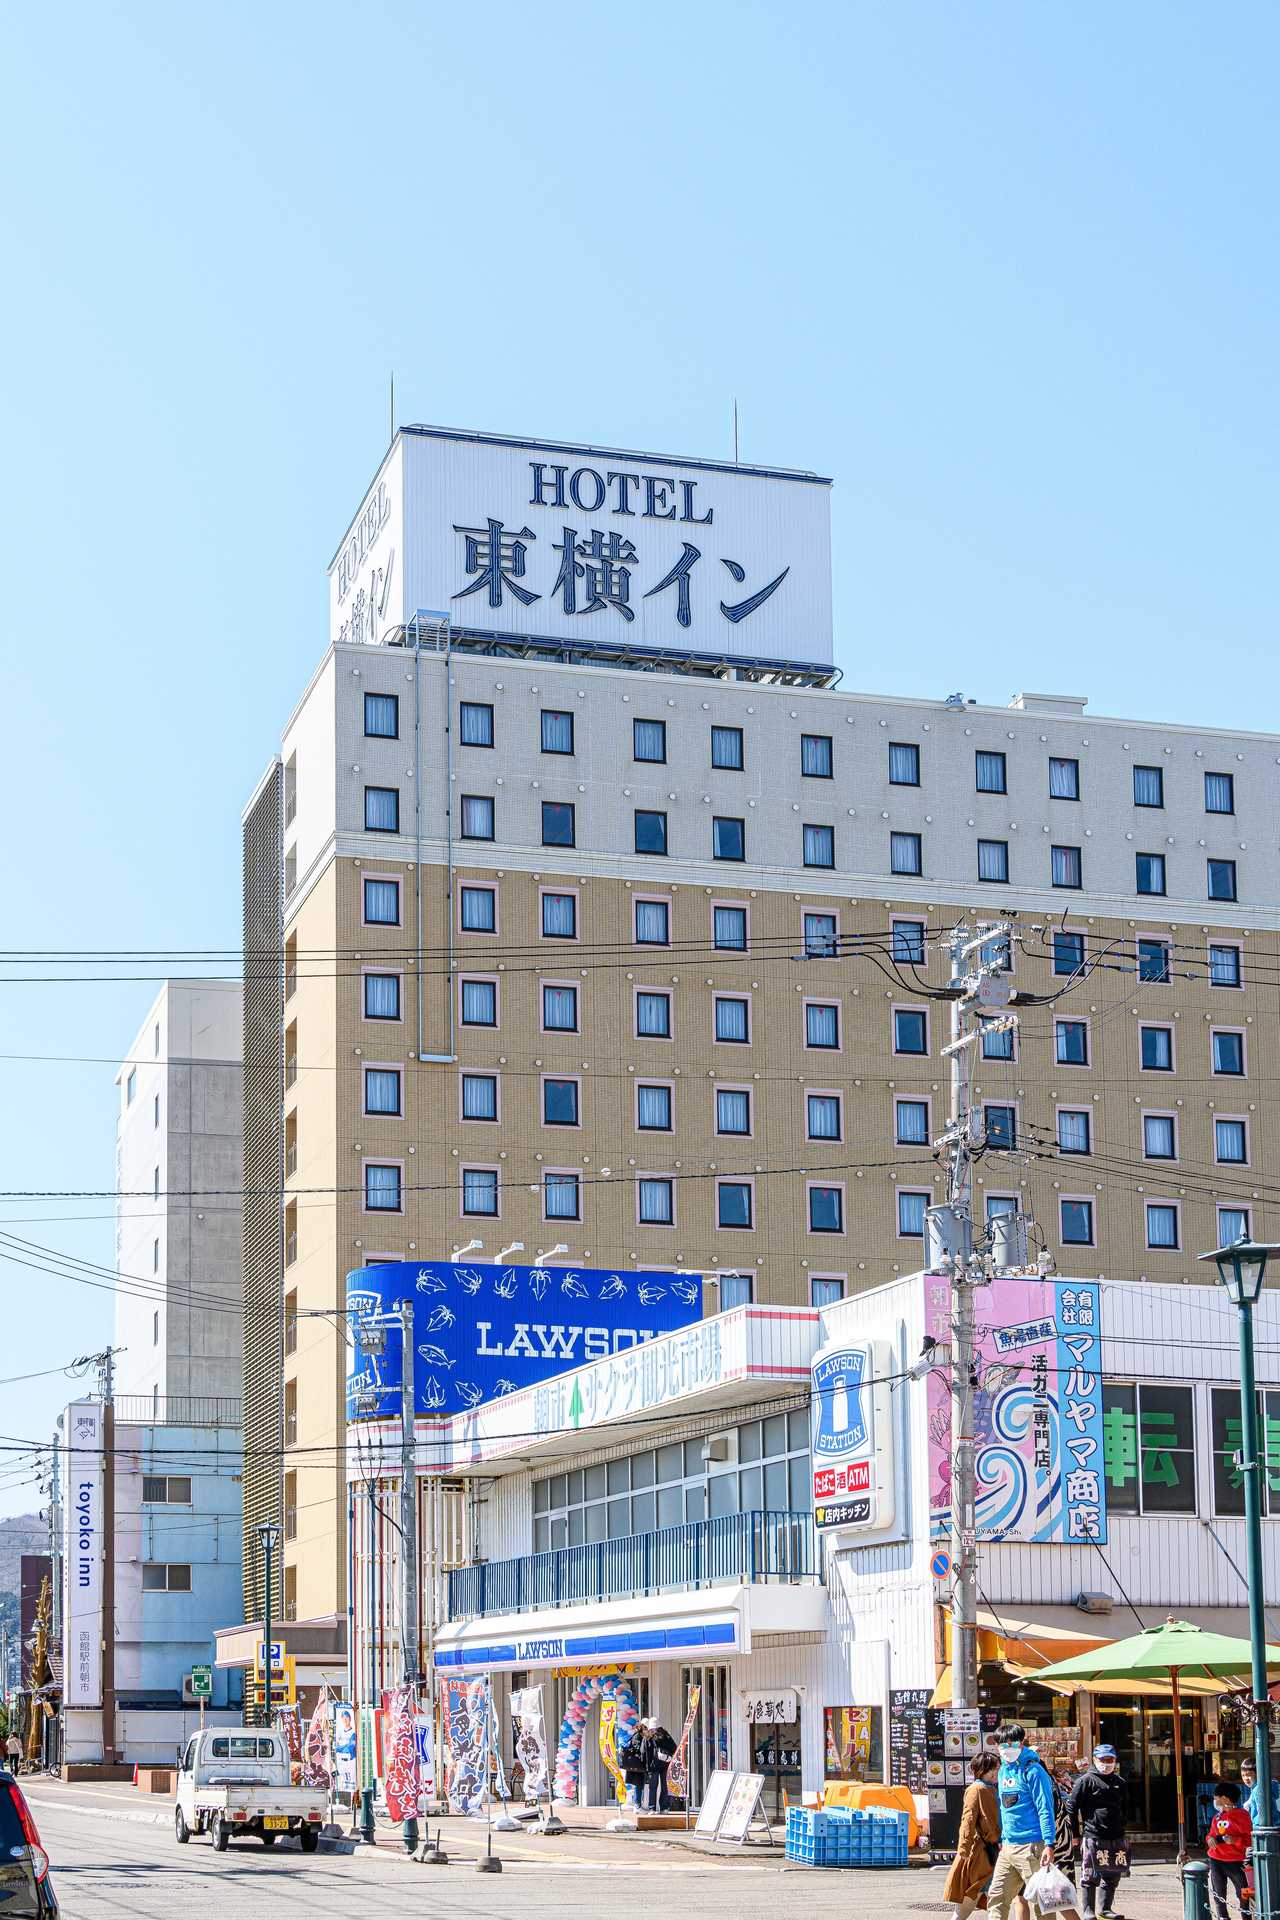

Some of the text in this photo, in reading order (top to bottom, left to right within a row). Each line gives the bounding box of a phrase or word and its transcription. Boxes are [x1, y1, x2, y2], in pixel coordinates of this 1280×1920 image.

[528, 462, 714, 525] HOTEL
[337, 481, 392, 606] HOTEL
[451, 517, 790, 628] 東横イン
[347, 1297, 373, 1314] SON
[346, 1369, 373, 1395] TION
[817, 1356, 862, 1383] LAWSON
[819, 1425, 863, 1450] STATION
[1062, 1332, 1101, 1540] マルヤマ商店
[815, 1467, 869, 1494] たばこ 酒 ATM
[825, 1503, 869, 1523] 店内キッチン
[75, 1481, 95, 1588] toyoko inn
[517, 1638, 564, 1661] LAWSON
